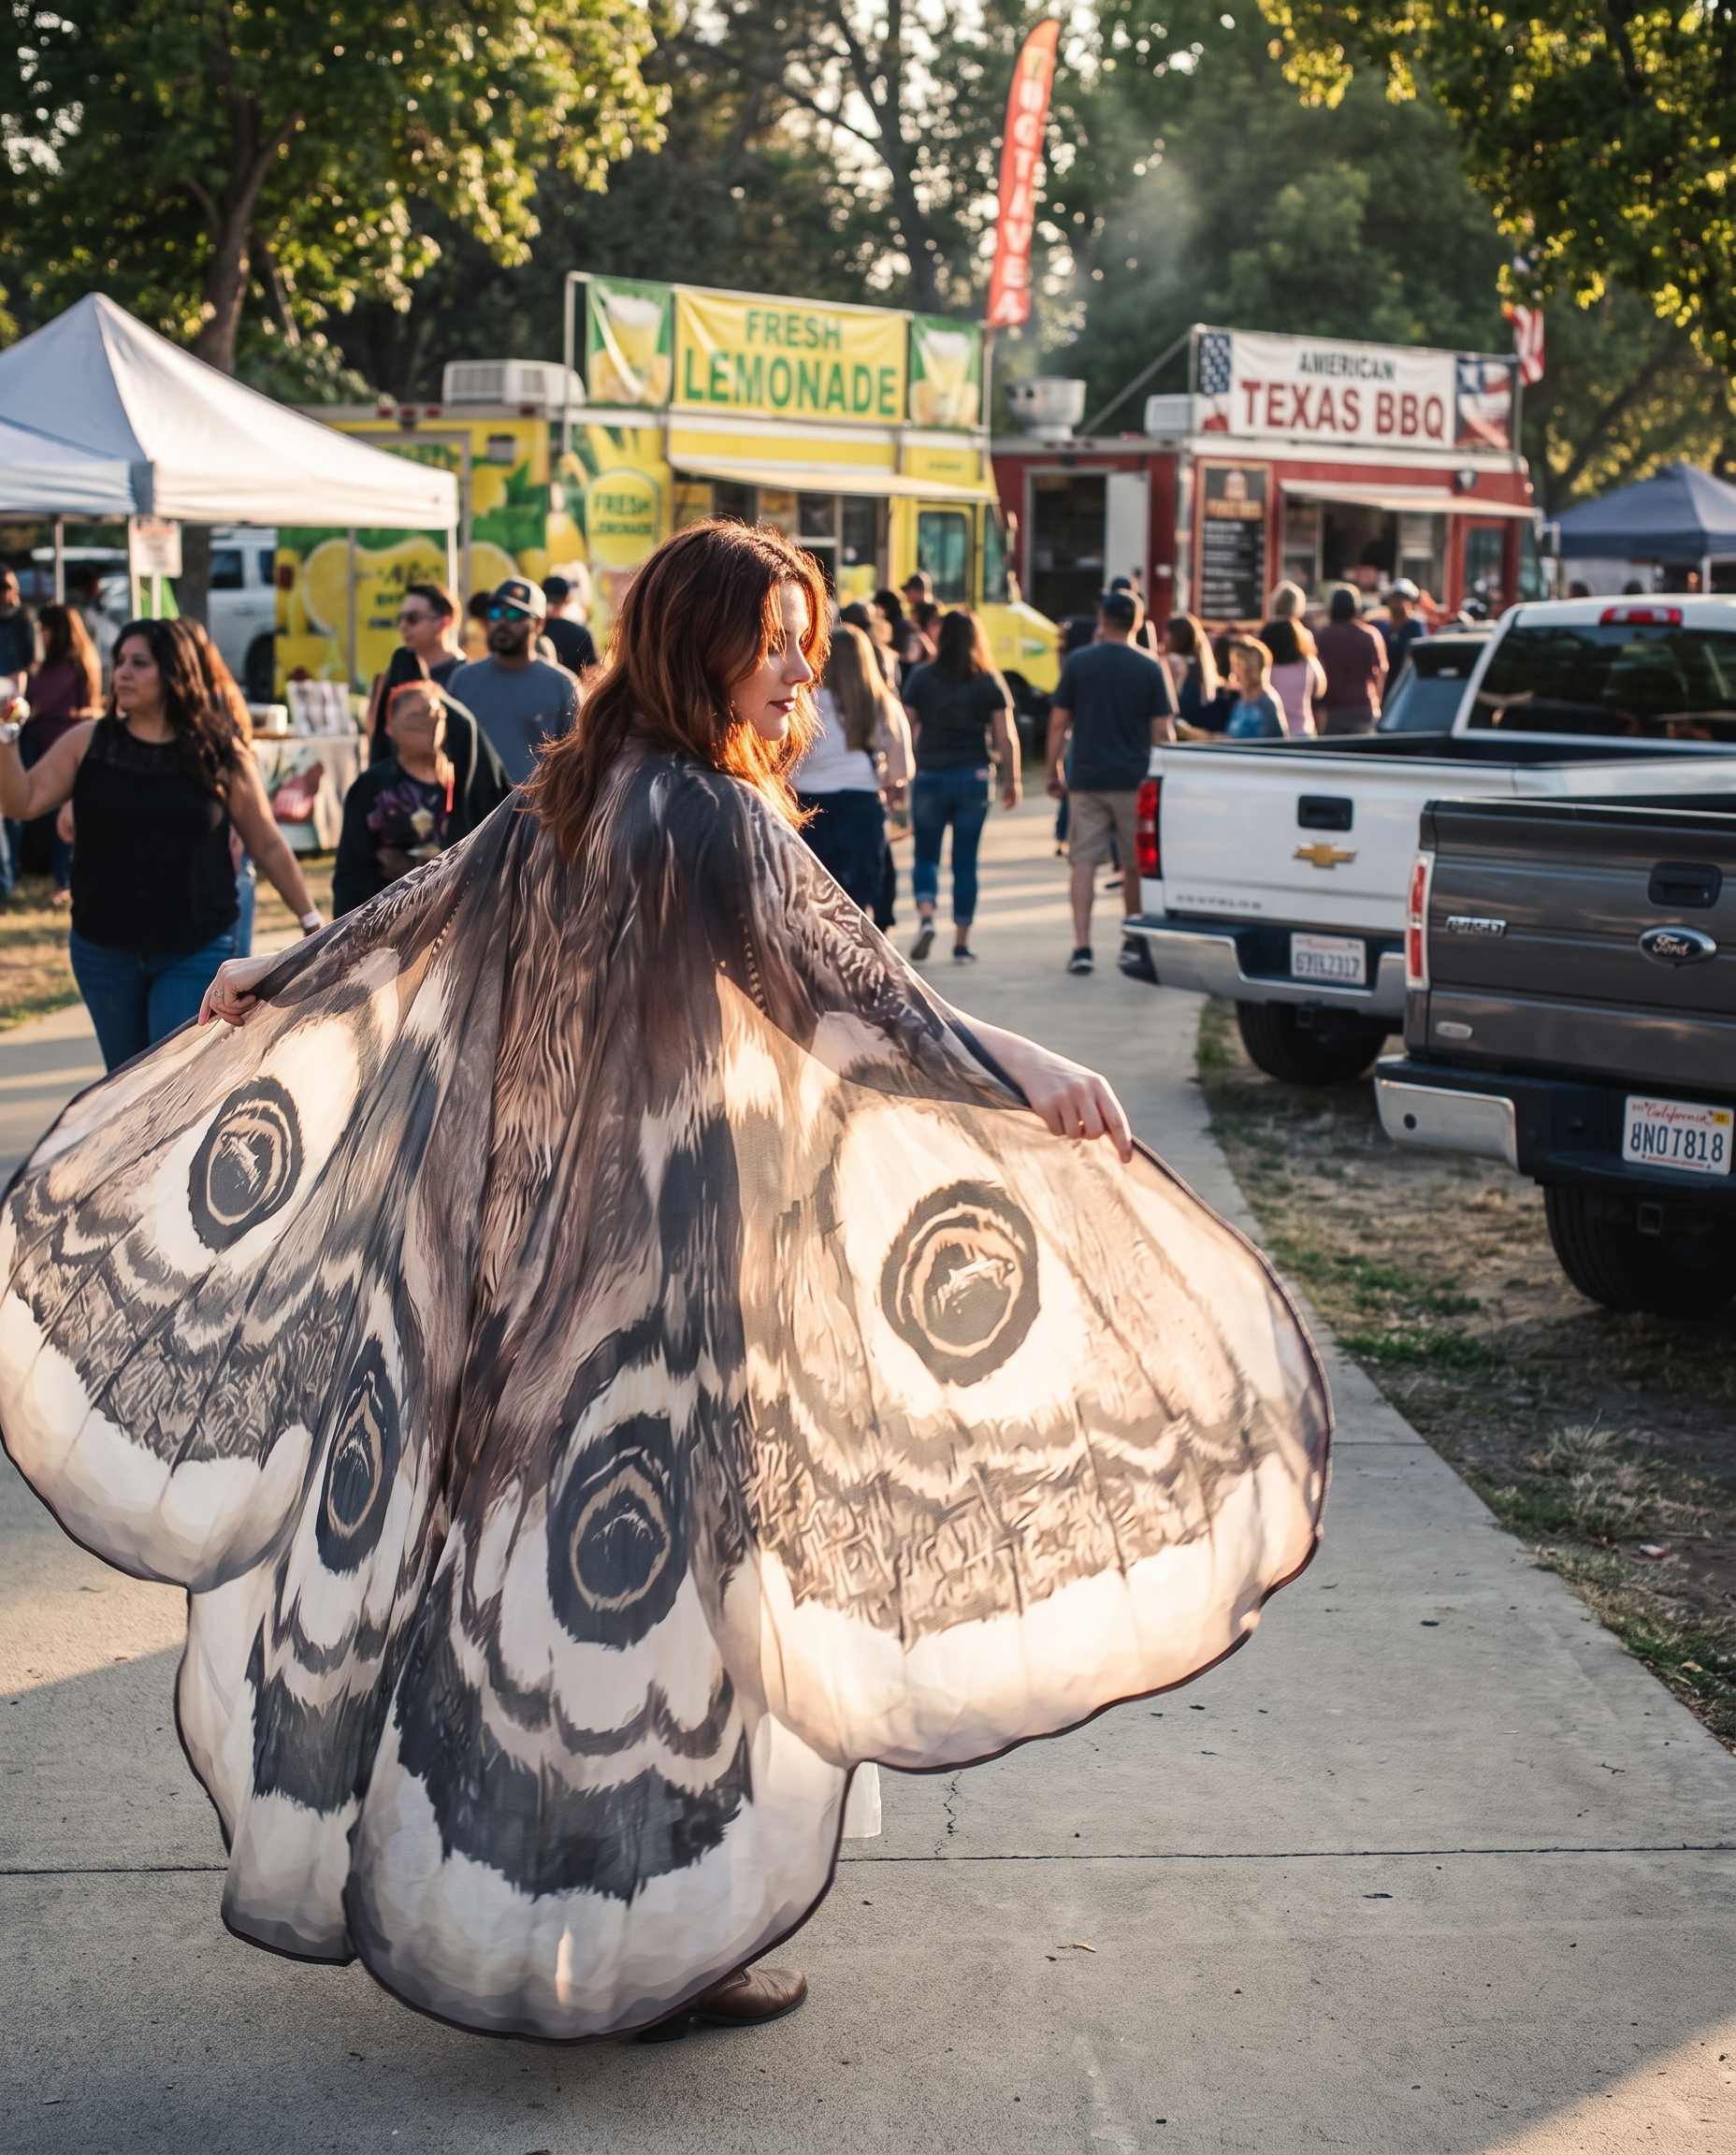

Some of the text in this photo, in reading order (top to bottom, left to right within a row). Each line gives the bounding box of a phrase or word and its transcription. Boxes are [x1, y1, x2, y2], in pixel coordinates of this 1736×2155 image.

[746, 309, 842, 349] FRESH
[686, 349, 897, 414] LEMONADE
[1297, 351, 1396, 382] AMERICAN
[1241, 380, 1444, 441] TEXAS BBQ
[1652, 933, 1690, 957] Ford
[1646, 1102, 1709, 1124] California
